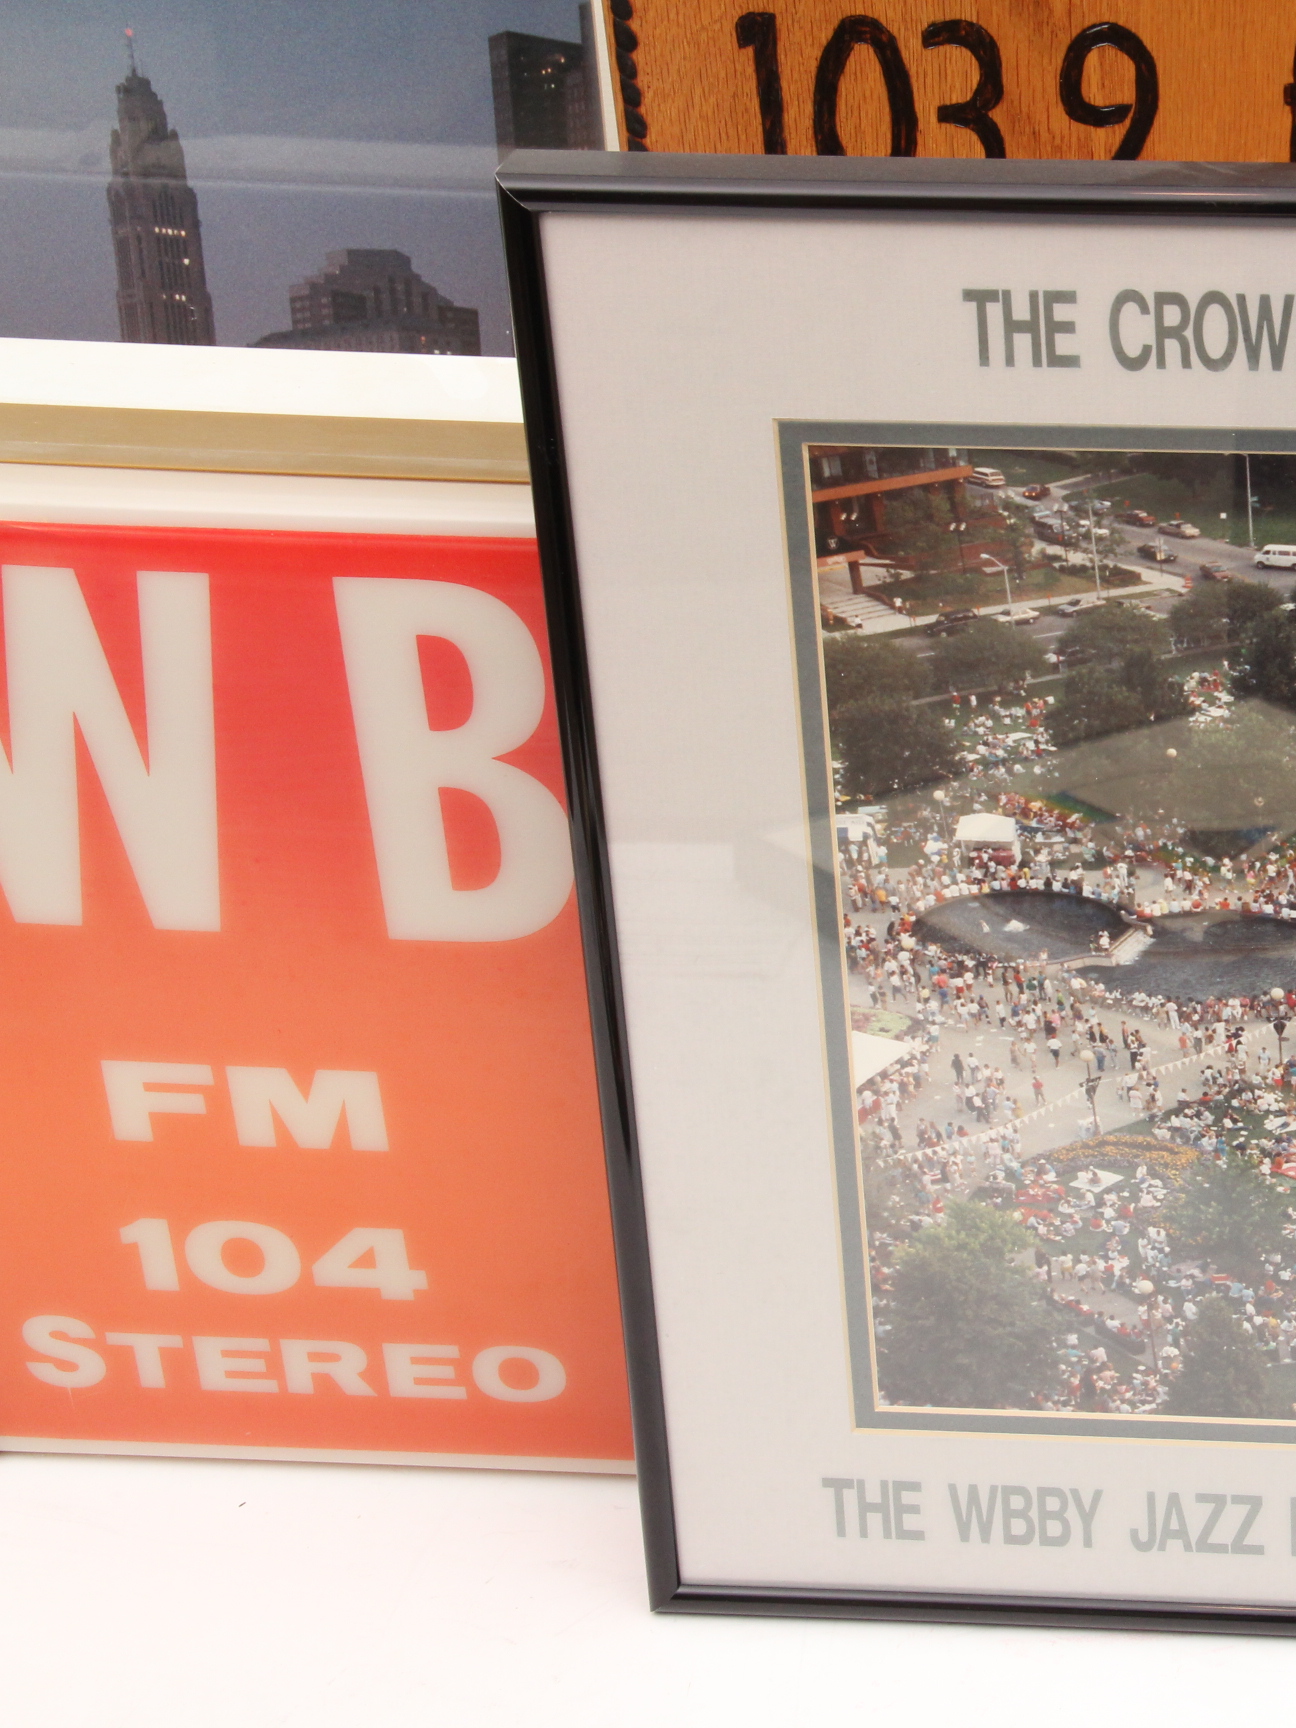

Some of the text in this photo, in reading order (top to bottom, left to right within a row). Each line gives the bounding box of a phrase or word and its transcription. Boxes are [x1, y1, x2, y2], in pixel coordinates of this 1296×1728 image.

[962, 288, 1081, 369] THE
[101, 1060, 390, 1152] FM
[118, 1217, 430, 1300] 104
[21, 1314, 568, 1404] STEREO
[821, 1476, 926, 1542] THE
[947, 1481, 1104, 1549] WBBY
[1128, 1490, 1266, 1556] JAZZ
